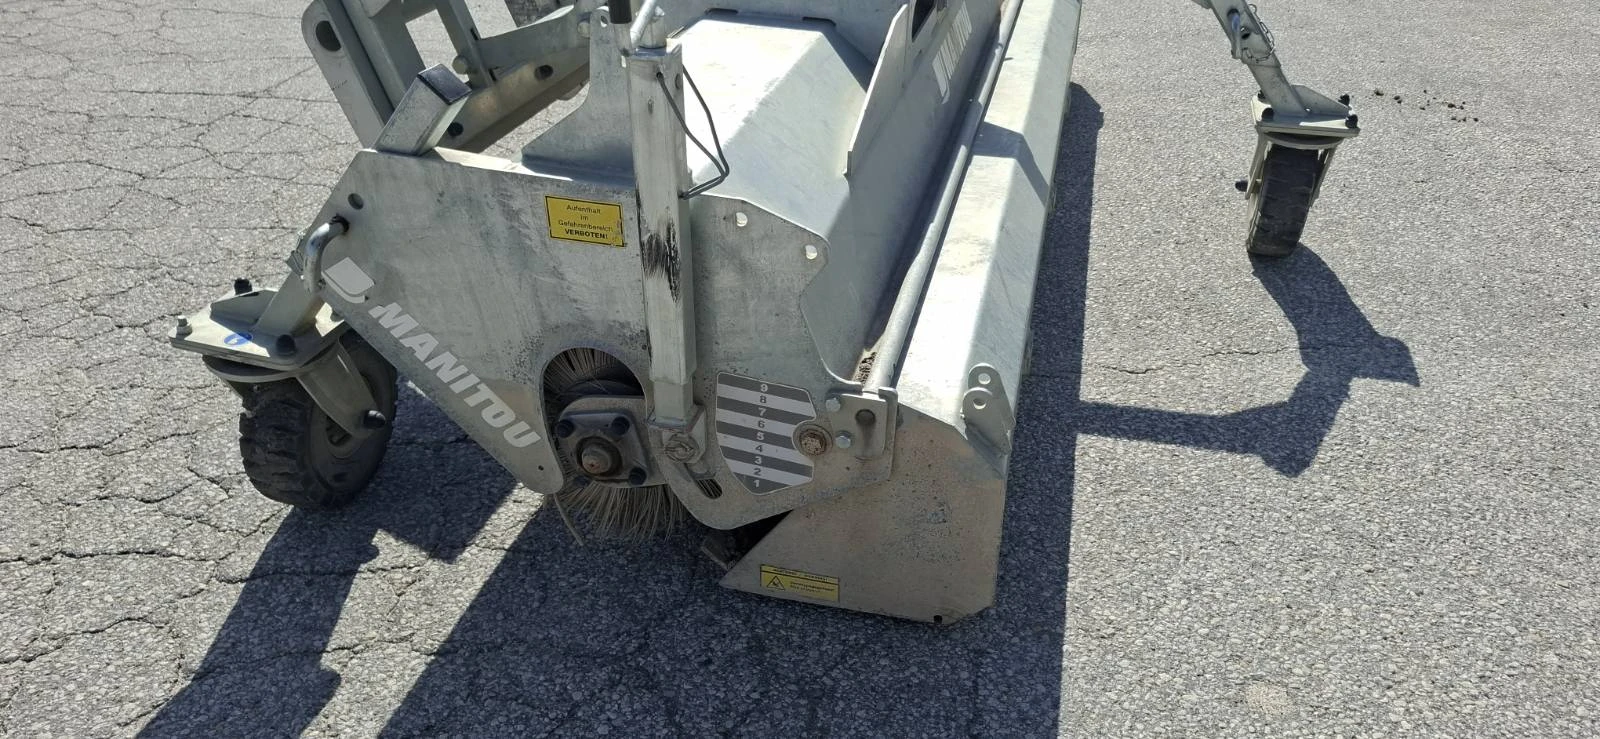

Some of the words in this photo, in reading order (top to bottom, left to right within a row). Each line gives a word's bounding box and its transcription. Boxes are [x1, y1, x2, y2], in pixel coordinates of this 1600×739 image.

[564, 228, 609, 240] VERBOTEN!
[368, 302, 542, 448] MANITOU
[760, 383, 769, 392] 9
[759, 395, 767, 404] 8
[758, 407, 767, 416] 7
[757, 420, 766, 429] 6
[756, 432, 765, 441] 5
[755, 444, 763, 453] 4
[754, 456, 762, 465] 3
[753, 467, 762, 476] 2
[753, 479, 760, 488] 1
